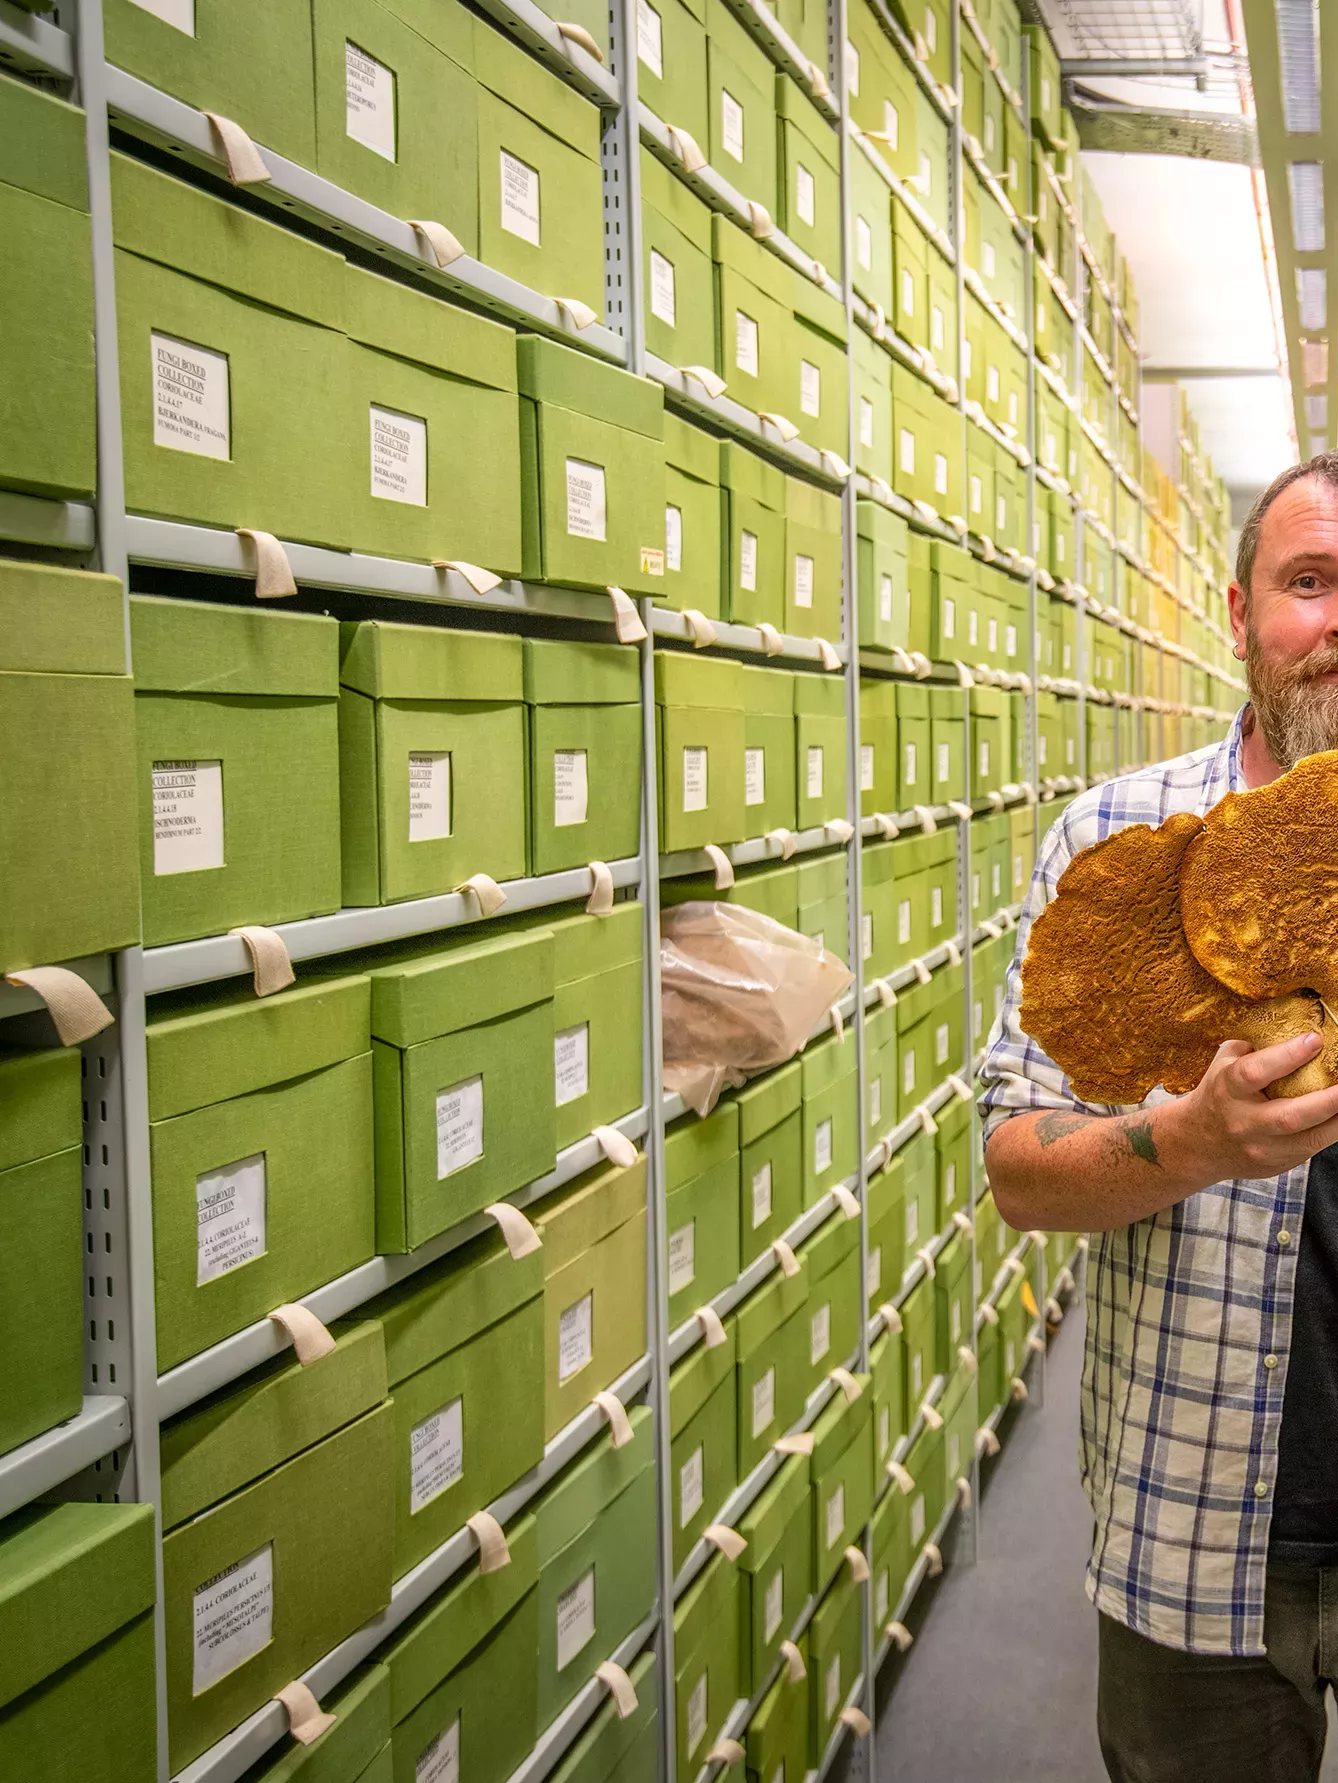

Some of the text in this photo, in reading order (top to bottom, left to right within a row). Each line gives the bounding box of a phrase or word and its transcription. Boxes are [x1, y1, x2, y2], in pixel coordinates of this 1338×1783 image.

[347, 55, 376, 76] OLLECTION
[157, 348, 206, 378] FUNGI BOXED
[157, 365, 205, 392] COLLECTION
[157, 379, 203, 406] CORIOLACEAE
[374, 419, 391, 433] FUNGI
[374, 431, 409, 453] COLLECTION
[153, 774, 196, 787] COLLECTION
[153, 789, 195, 801] CORIOLACEAE
[198, 1200, 235, 1224] COLLECTION
[195, 1562, 240, 1594] COLLECTION
[215, 1571, 258, 1604] CORIOLACEAE
